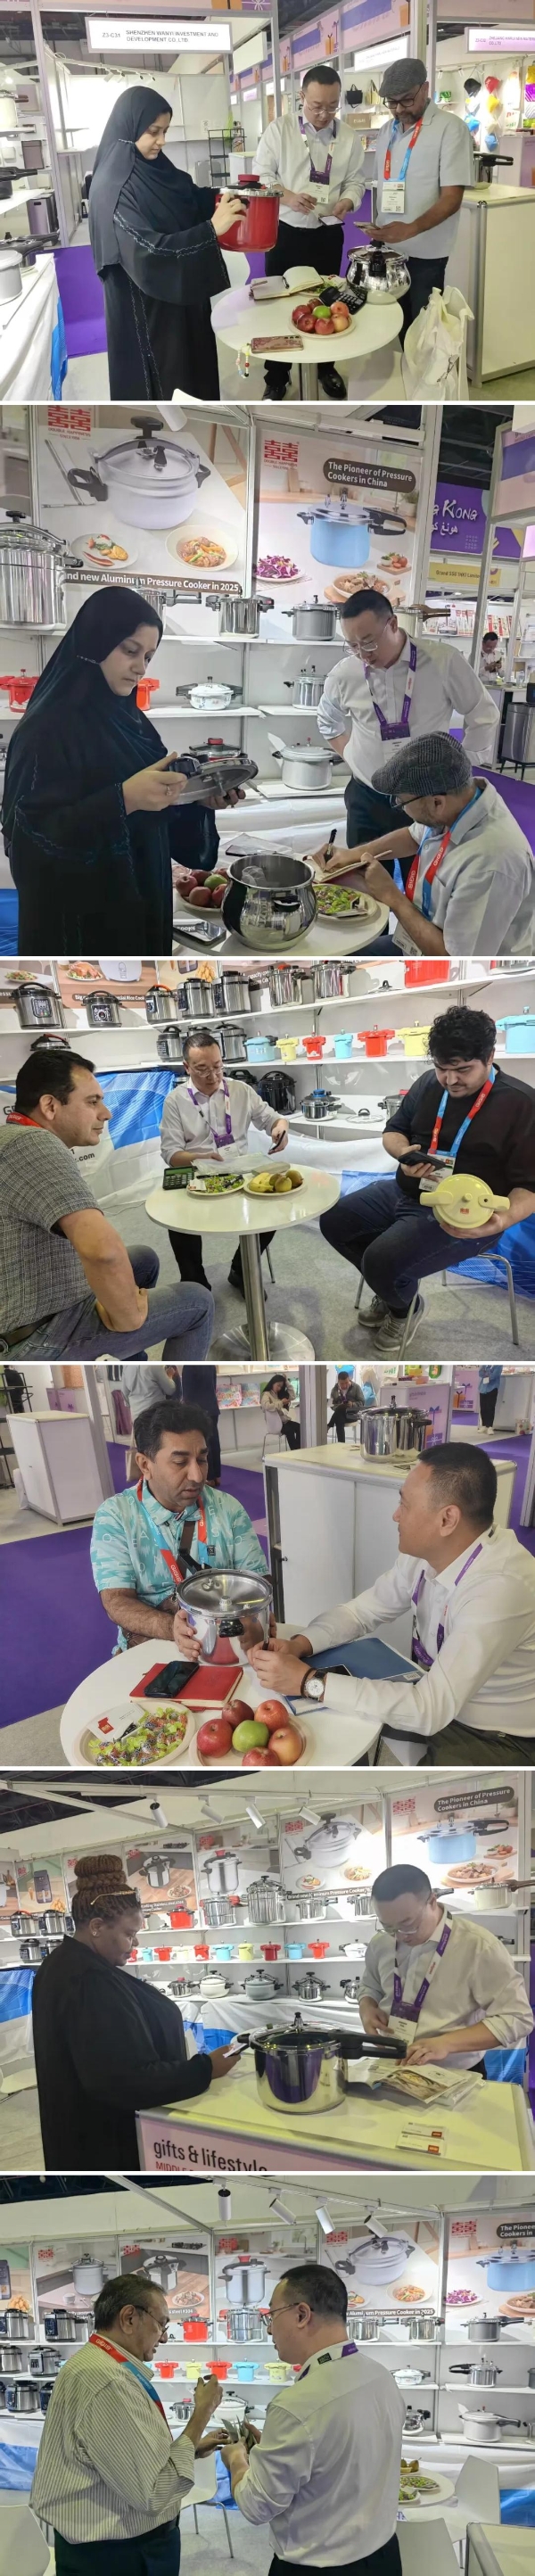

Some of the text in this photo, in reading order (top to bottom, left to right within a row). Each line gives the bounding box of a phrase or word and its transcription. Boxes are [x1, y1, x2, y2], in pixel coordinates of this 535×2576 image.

[328, 472, 388, 487] Cookers in China
[329, 462, 412, 482] The Pioneer of Pressure
[442, 500, 478, 521] KONG
[147, 578, 182, 588] Pressure
[184, 581, 210, 590] Cooker
[212, 582, 219, 590] in
[220, 583, 239, 591] 2025
[450, 1796, 473, 1804] Pioneer
[482, 1789, 511, 1798] Pressure
[438, 1802, 462, 1812] Cookers
[153, 2139, 185, 2159] gifts
[188, 2145, 199, 2163] &
